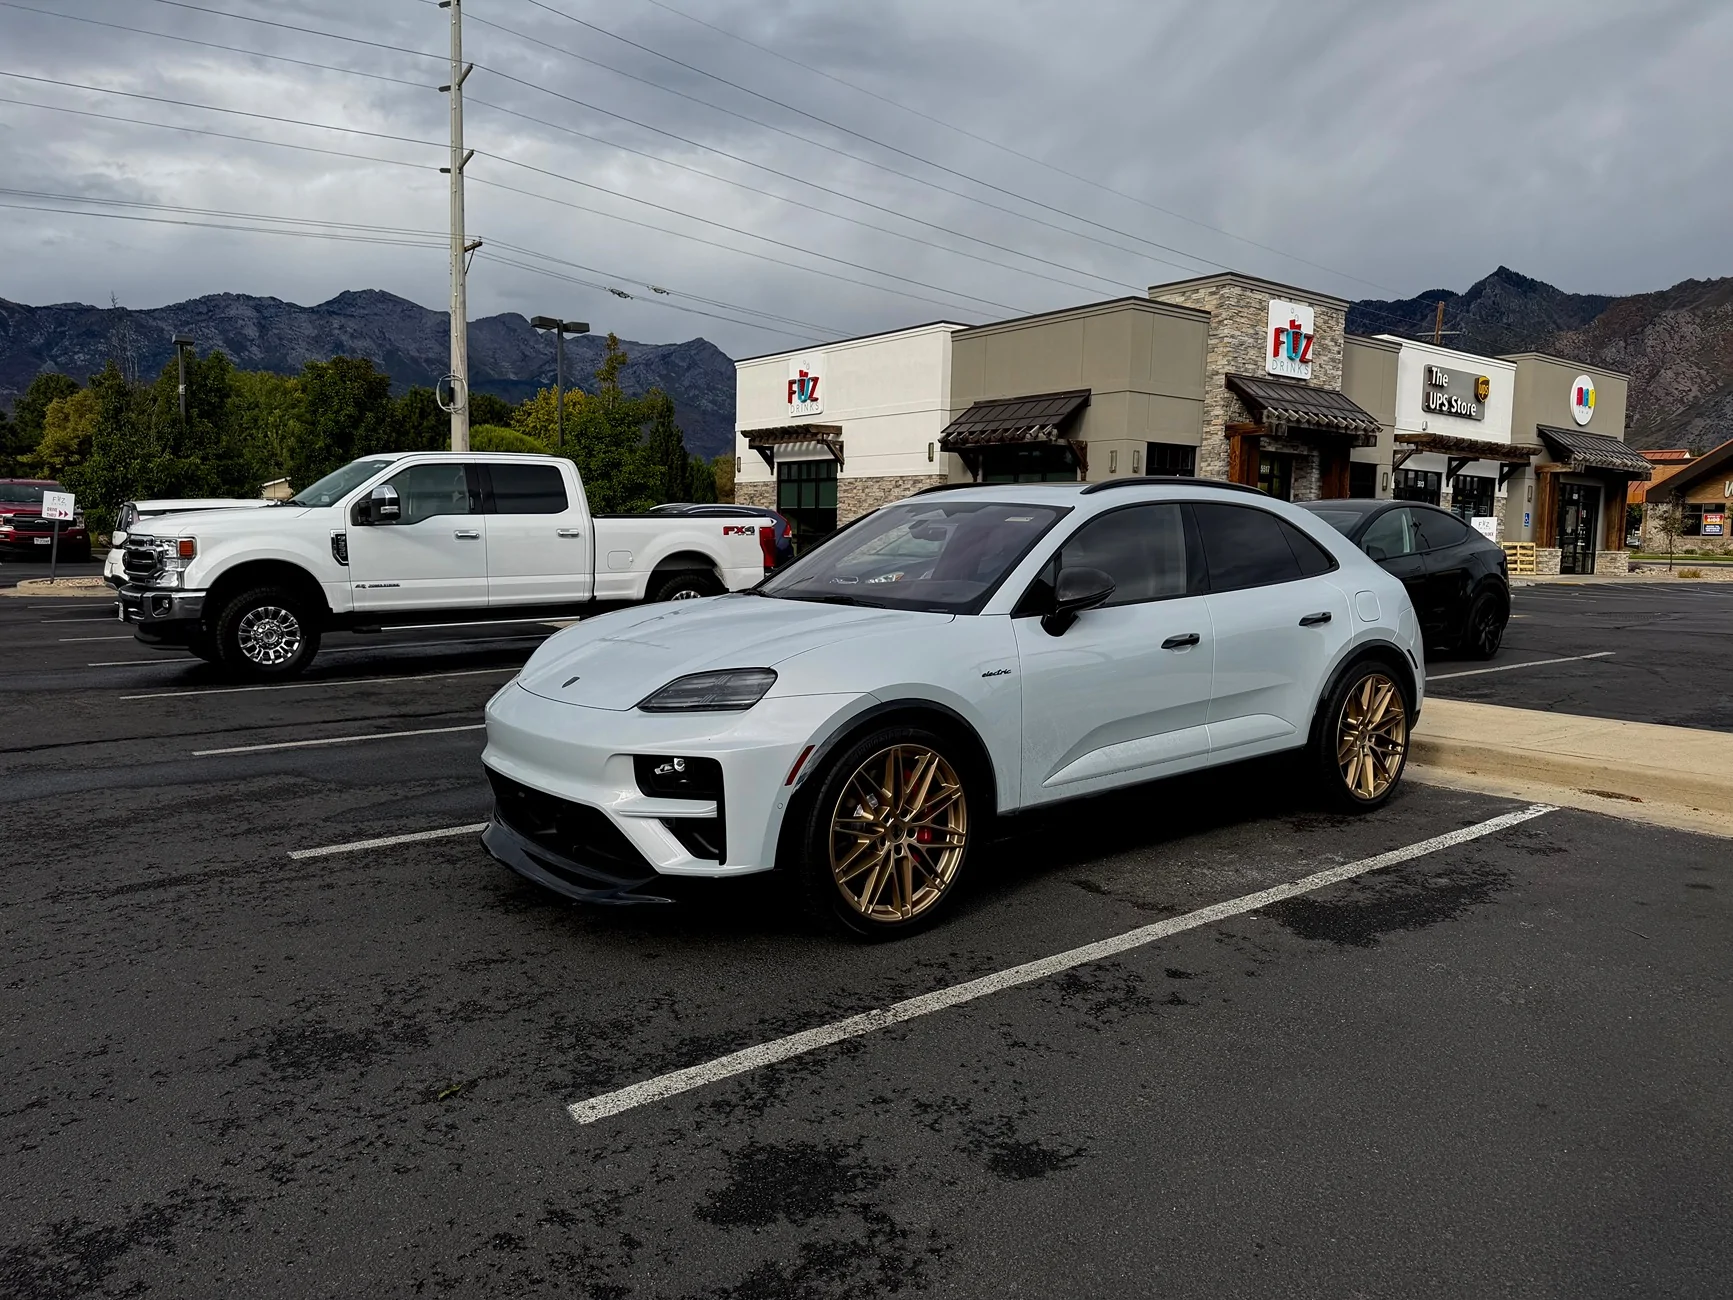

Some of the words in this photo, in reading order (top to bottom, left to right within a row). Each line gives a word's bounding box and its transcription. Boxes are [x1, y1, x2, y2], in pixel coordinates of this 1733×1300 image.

[1271, 359, 1310, 375] DRINKS
[1431, 366, 1449, 387] The
[789, 402, 820, 414] DRINKS
[1429, 391, 1449, 411] UPS
[1450, 395, 1477, 416] Store
[723, 526, 756, 536] FX4
[981, 669, 1012, 678] electric
